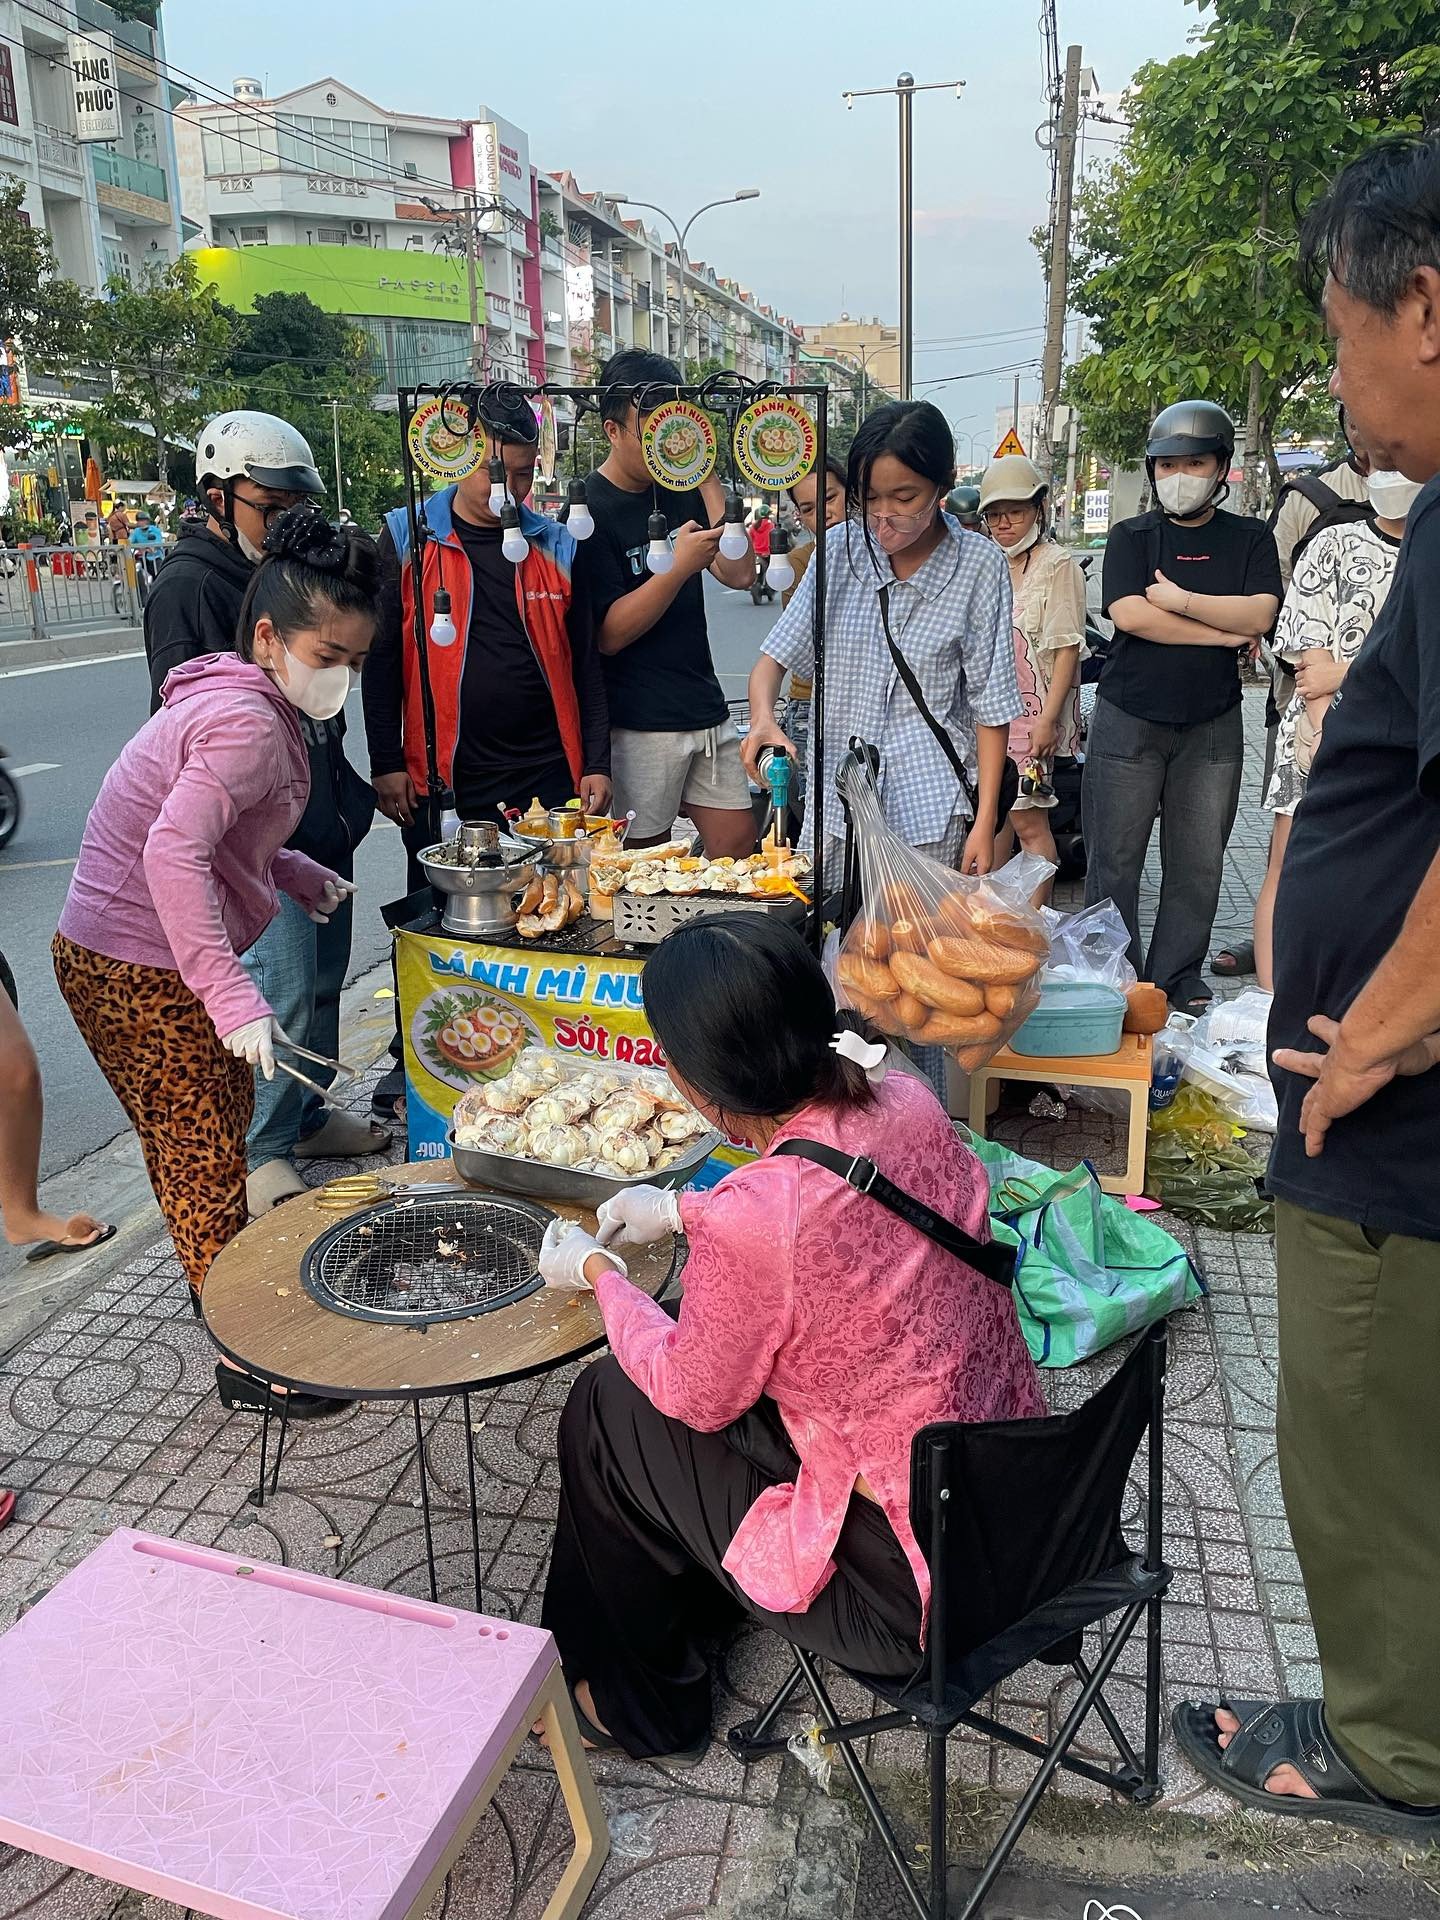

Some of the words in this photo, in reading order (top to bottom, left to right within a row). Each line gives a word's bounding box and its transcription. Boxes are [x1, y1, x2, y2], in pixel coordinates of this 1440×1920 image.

[72, 56, 110, 82] TĂNG
[75, 86, 114, 113] PHÚC
[80, 118, 115, 132] BRIDAL
[485, 134, 497, 192] FLAMINGO
[379, 277, 459, 295] PASSIO
[457, 465, 472, 477] CUA
[688, 472, 702, 485] CUA
[767, 478, 784, 486] CUA
[534, 963, 589, 1003] MÌ
[553, 1014, 610, 1058] Sốt
